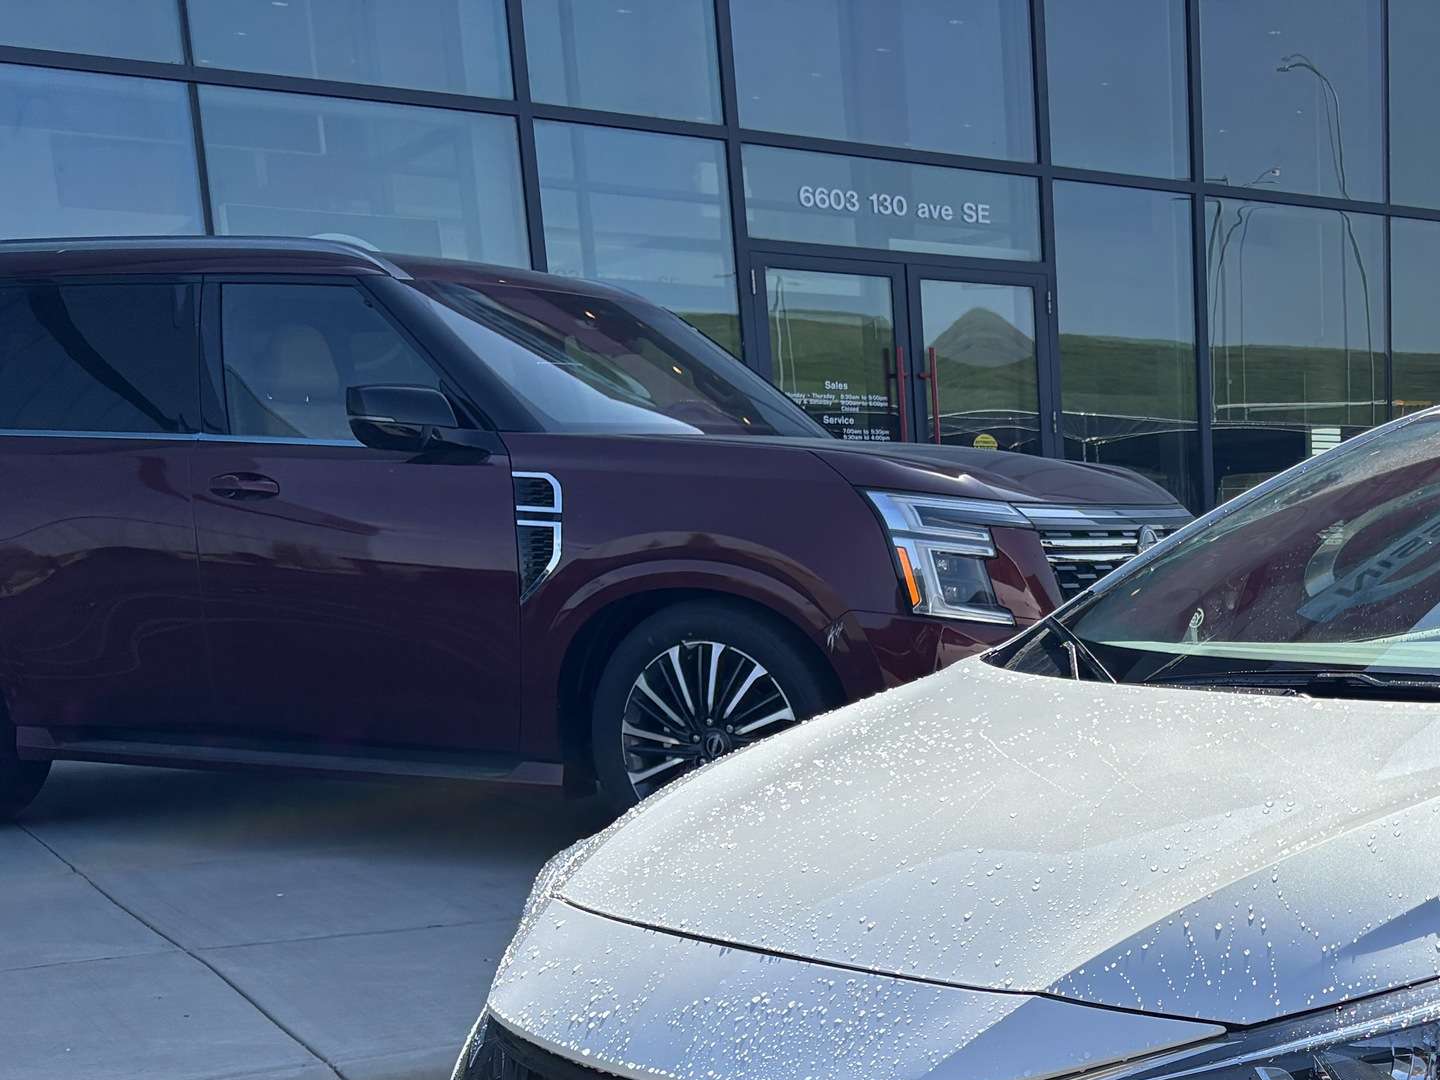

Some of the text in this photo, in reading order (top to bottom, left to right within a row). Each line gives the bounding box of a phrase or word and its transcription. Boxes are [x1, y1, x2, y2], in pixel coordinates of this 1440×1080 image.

[799, 185, 991, 225] 6603 130 ave SE
[824, 380, 849, 390] Sales
[823, 415, 855, 425] Service
